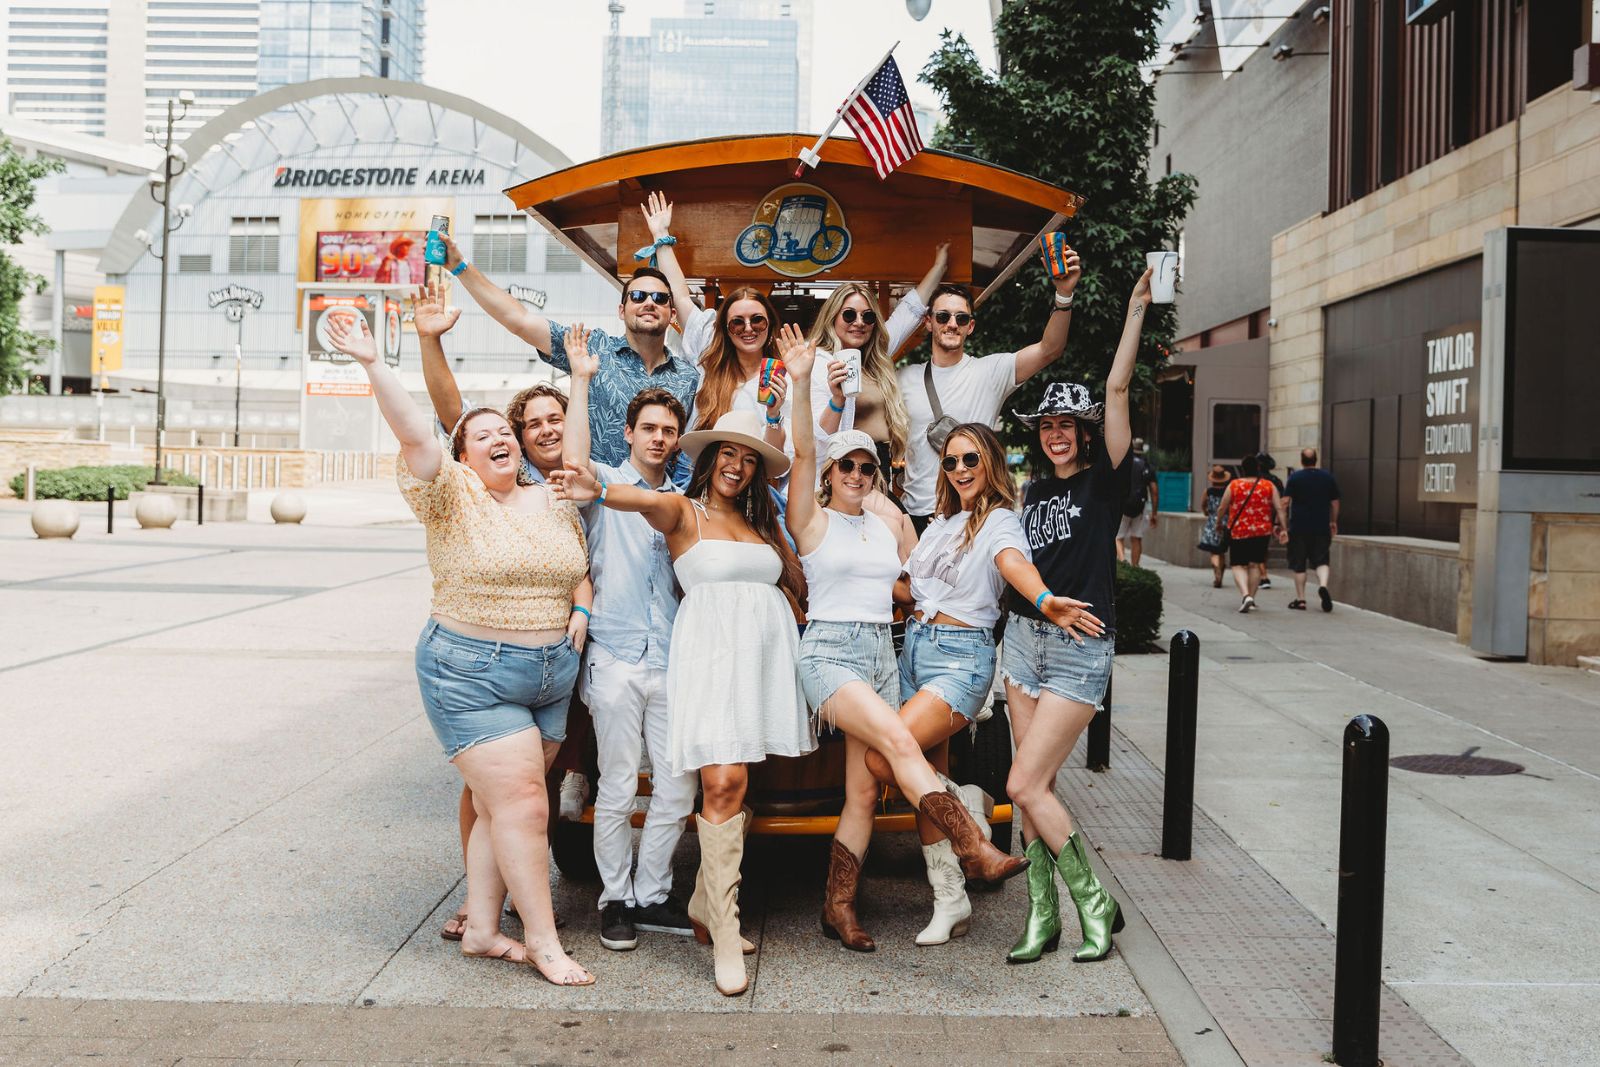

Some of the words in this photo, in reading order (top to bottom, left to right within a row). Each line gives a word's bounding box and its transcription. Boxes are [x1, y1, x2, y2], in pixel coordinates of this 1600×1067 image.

[274, 167, 418, 187] BRIDGESTONE
[426, 169, 485, 185] ARENA
[336, 211, 369, 220] HOME
[374, 211, 388, 219] OF
[394, 210, 416, 219] THE
[1426, 332, 1475, 375] TAYLOR
[1426, 378, 1469, 417] SWIFT
[1424, 423, 1472, 455] EDUCATION
[1424, 463, 1456, 492] CENTER
